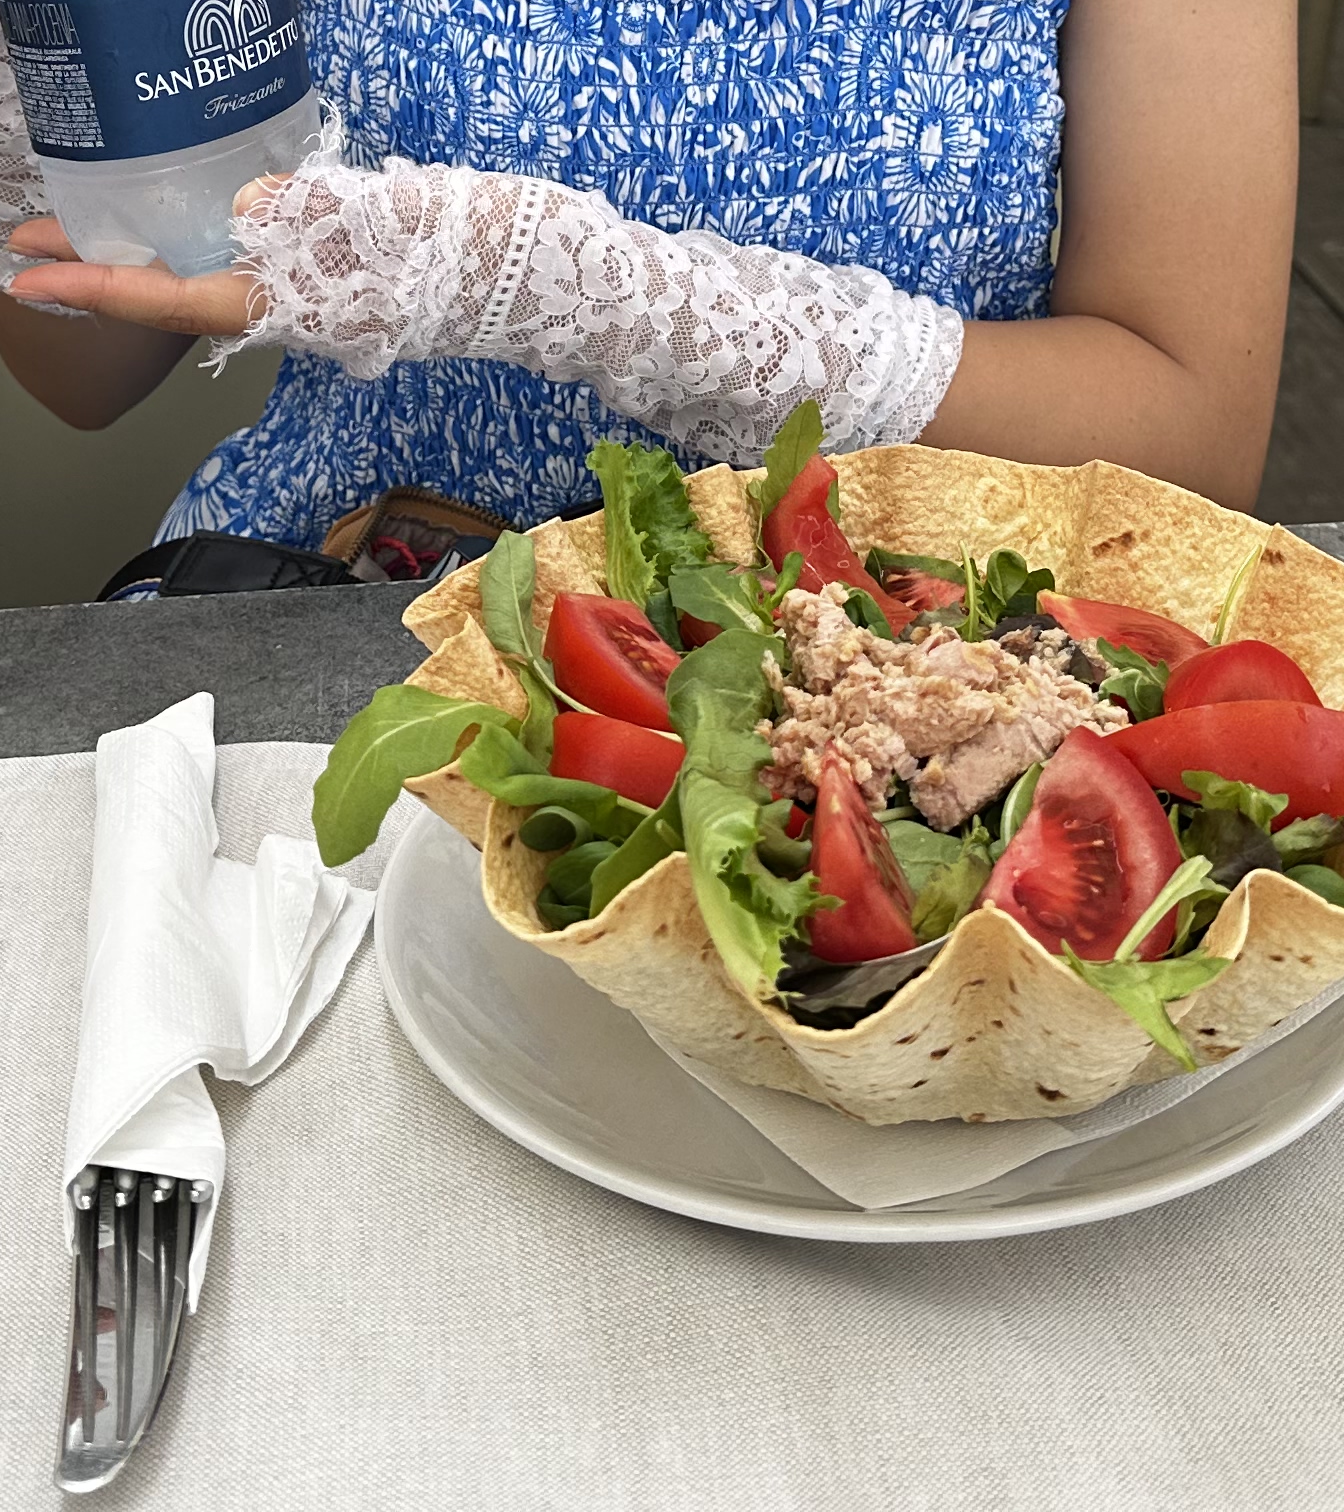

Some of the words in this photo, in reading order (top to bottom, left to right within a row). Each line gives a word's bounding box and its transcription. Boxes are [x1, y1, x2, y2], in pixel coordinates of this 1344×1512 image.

[135, 66, 194, 101] SAN
[193, 17, 299, 88] BENEDETTO
[204, 76, 286, 120] Frizzante
